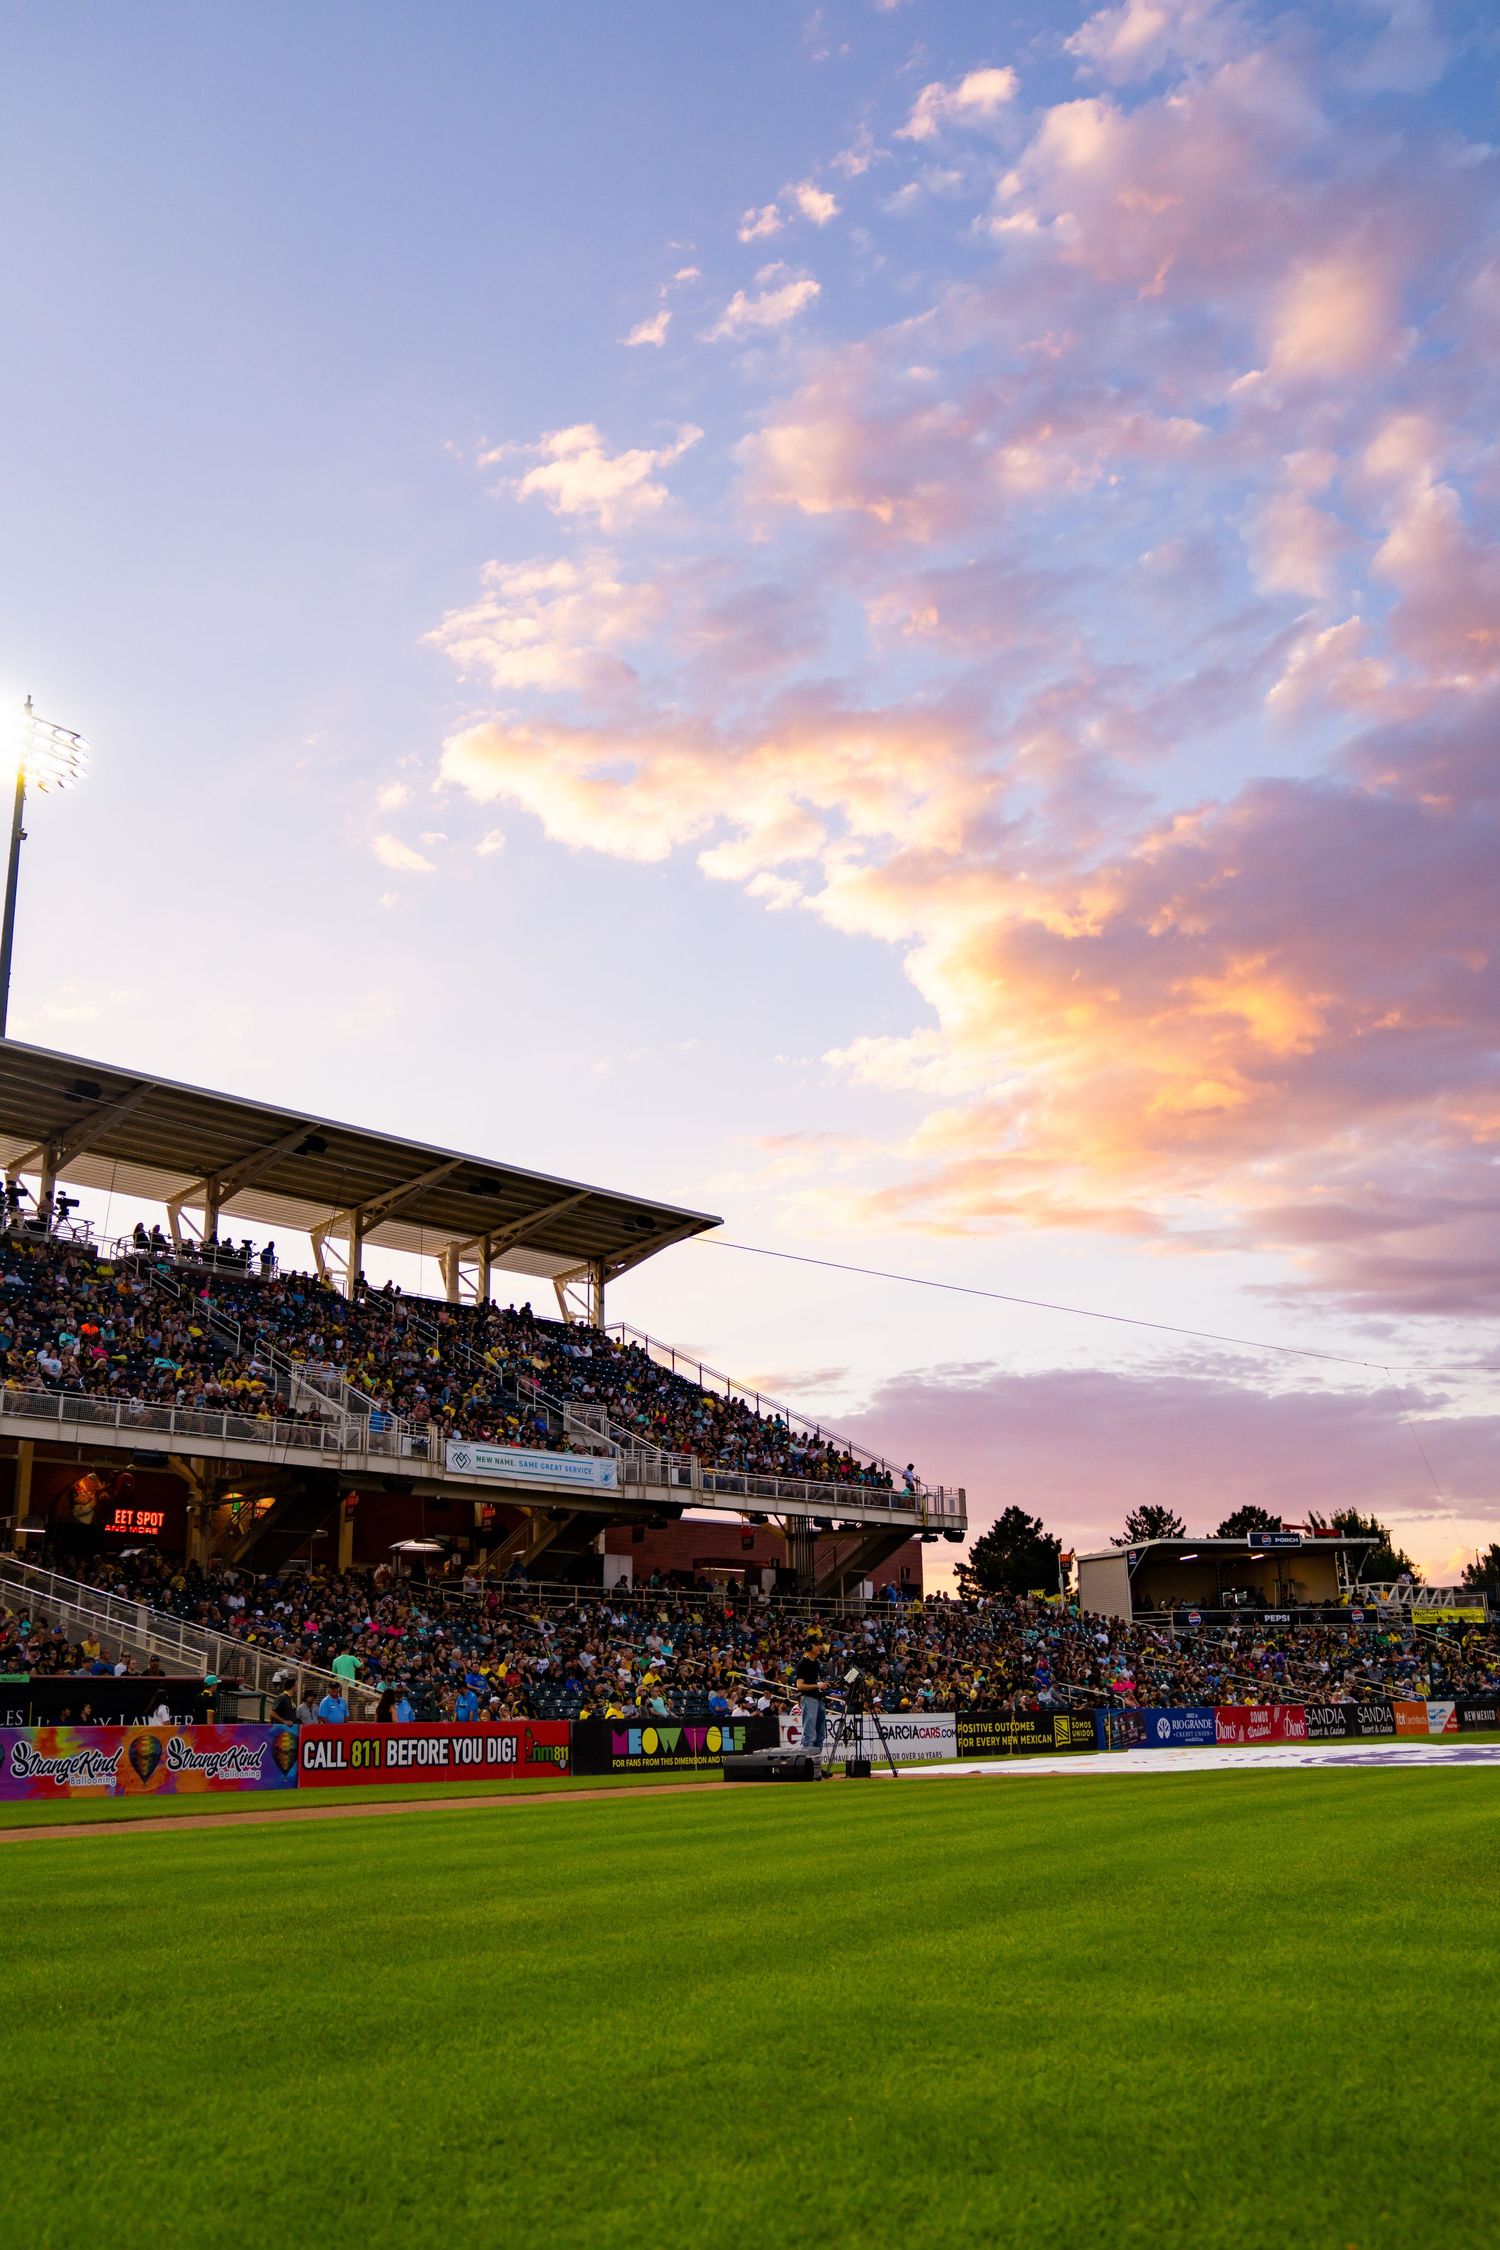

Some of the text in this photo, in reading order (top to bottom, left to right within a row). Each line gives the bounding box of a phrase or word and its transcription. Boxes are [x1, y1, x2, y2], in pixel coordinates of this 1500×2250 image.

[475, 1455, 594, 1475] NEW NAME. SAME GREAT SERVICE.
[115, 1509, 165, 1527] EET SPOT
[104, 1524, 159, 1535] AND MORE
[1264, 1614, 1290, 1622] PEPSI
[1304, 1708, 1346, 1725] SANDIA
[1357, 1706, 1394, 1723] SANDIA
[1464, 1711, 1476, 1722] NEW
[1476, 1709, 1496, 1720] MEXICO
[957, 1721, 1035, 1733] POSITIVE OUTCOMES
[1071, 1721, 1092, 1729] SOMOS
[1172, 1718, 1213, 1730] RIO GRANDE
[1215, 1712, 1236, 1740] Dion's
[1283, 1710, 1305, 1737] Dion's
[1308, 1728, 1323, 1736] Resort
[1329, 1725, 1346, 1735] Casino
[612, 1726, 746, 1755] MEOW WOLF
[958, 1734, 1052, 1748] FOR EVERY NEW MEXICAN
[167, 1737, 267, 1777] StrangeKind
[303, 1737, 517, 1769] CALL 811 BEFORE YOU DIG!
[901, 1752, 916, 1760] OVER
[917, 1752, 925, 1760] 50
[925, 1751, 943, 1759] YEARS
[11, 1741, 123, 1784] StrangeKind
[612, 1759, 625, 1768] FOR
[626, 1758, 641, 1767] FANS
[642, 1758, 660, 1767] FROM
[661, 1757, 673, 1766] THIS
[674, 1756, 707, 1765] DIMENSION
[708, 1755, 720, 1764] AND
[219, 1769, 261, 1779] Ballooning
[70, 1776, 116, 1786] Ballooning
